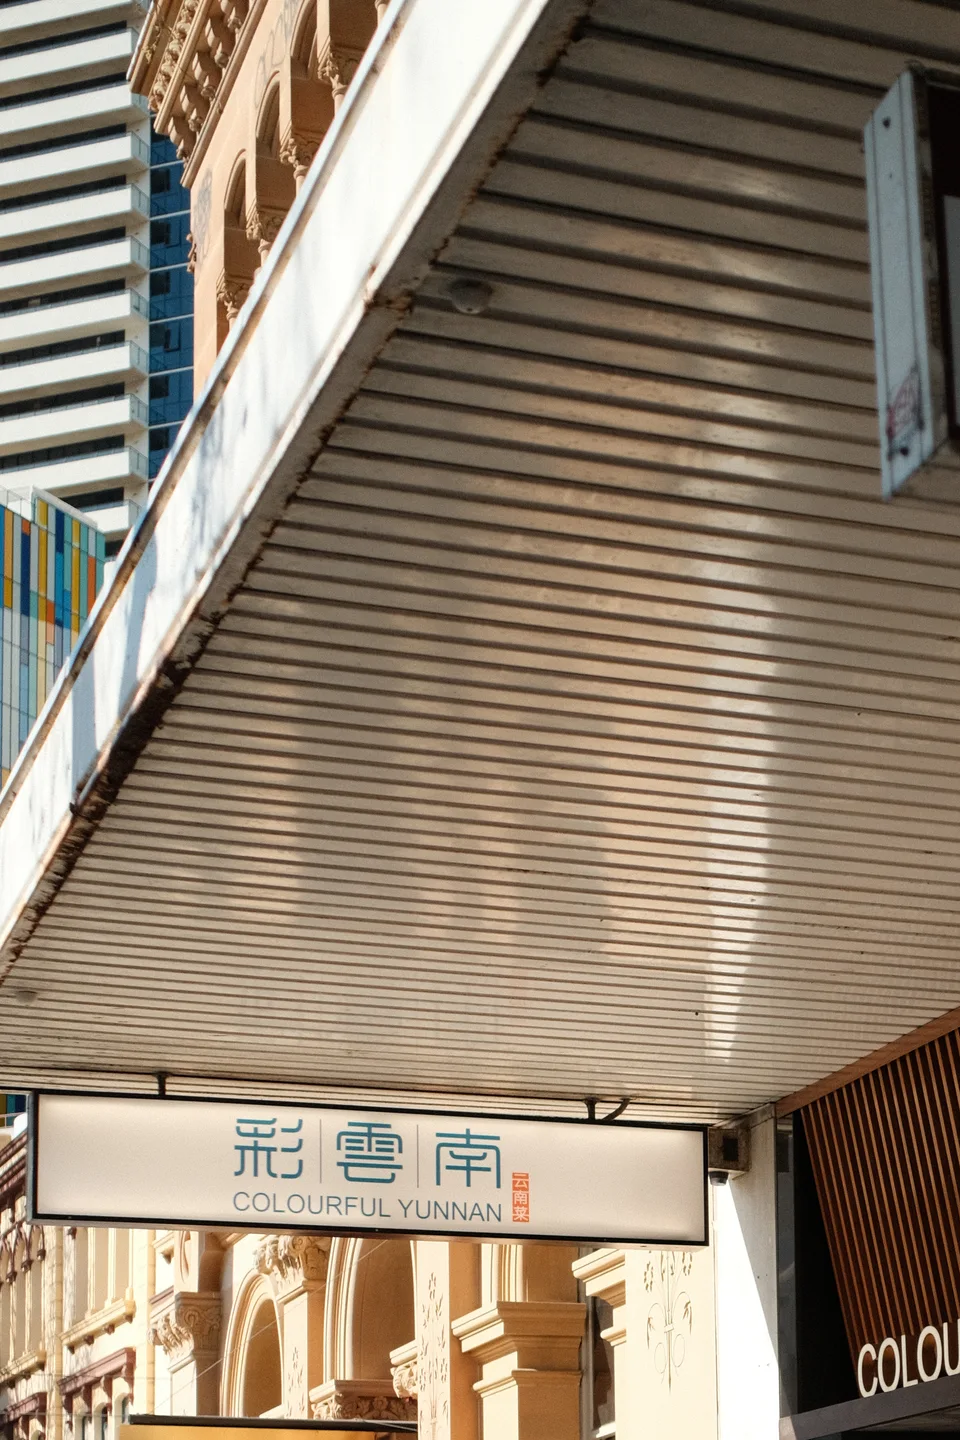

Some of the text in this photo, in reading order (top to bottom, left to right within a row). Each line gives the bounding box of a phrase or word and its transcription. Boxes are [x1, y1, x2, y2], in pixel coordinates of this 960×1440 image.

[233, 1117, 501, 1189] 彩雲南
[233, 1190, 502, 1223] COLOURFUL YUNNAN
[511, 1172, 530, 1222] 云南菜
